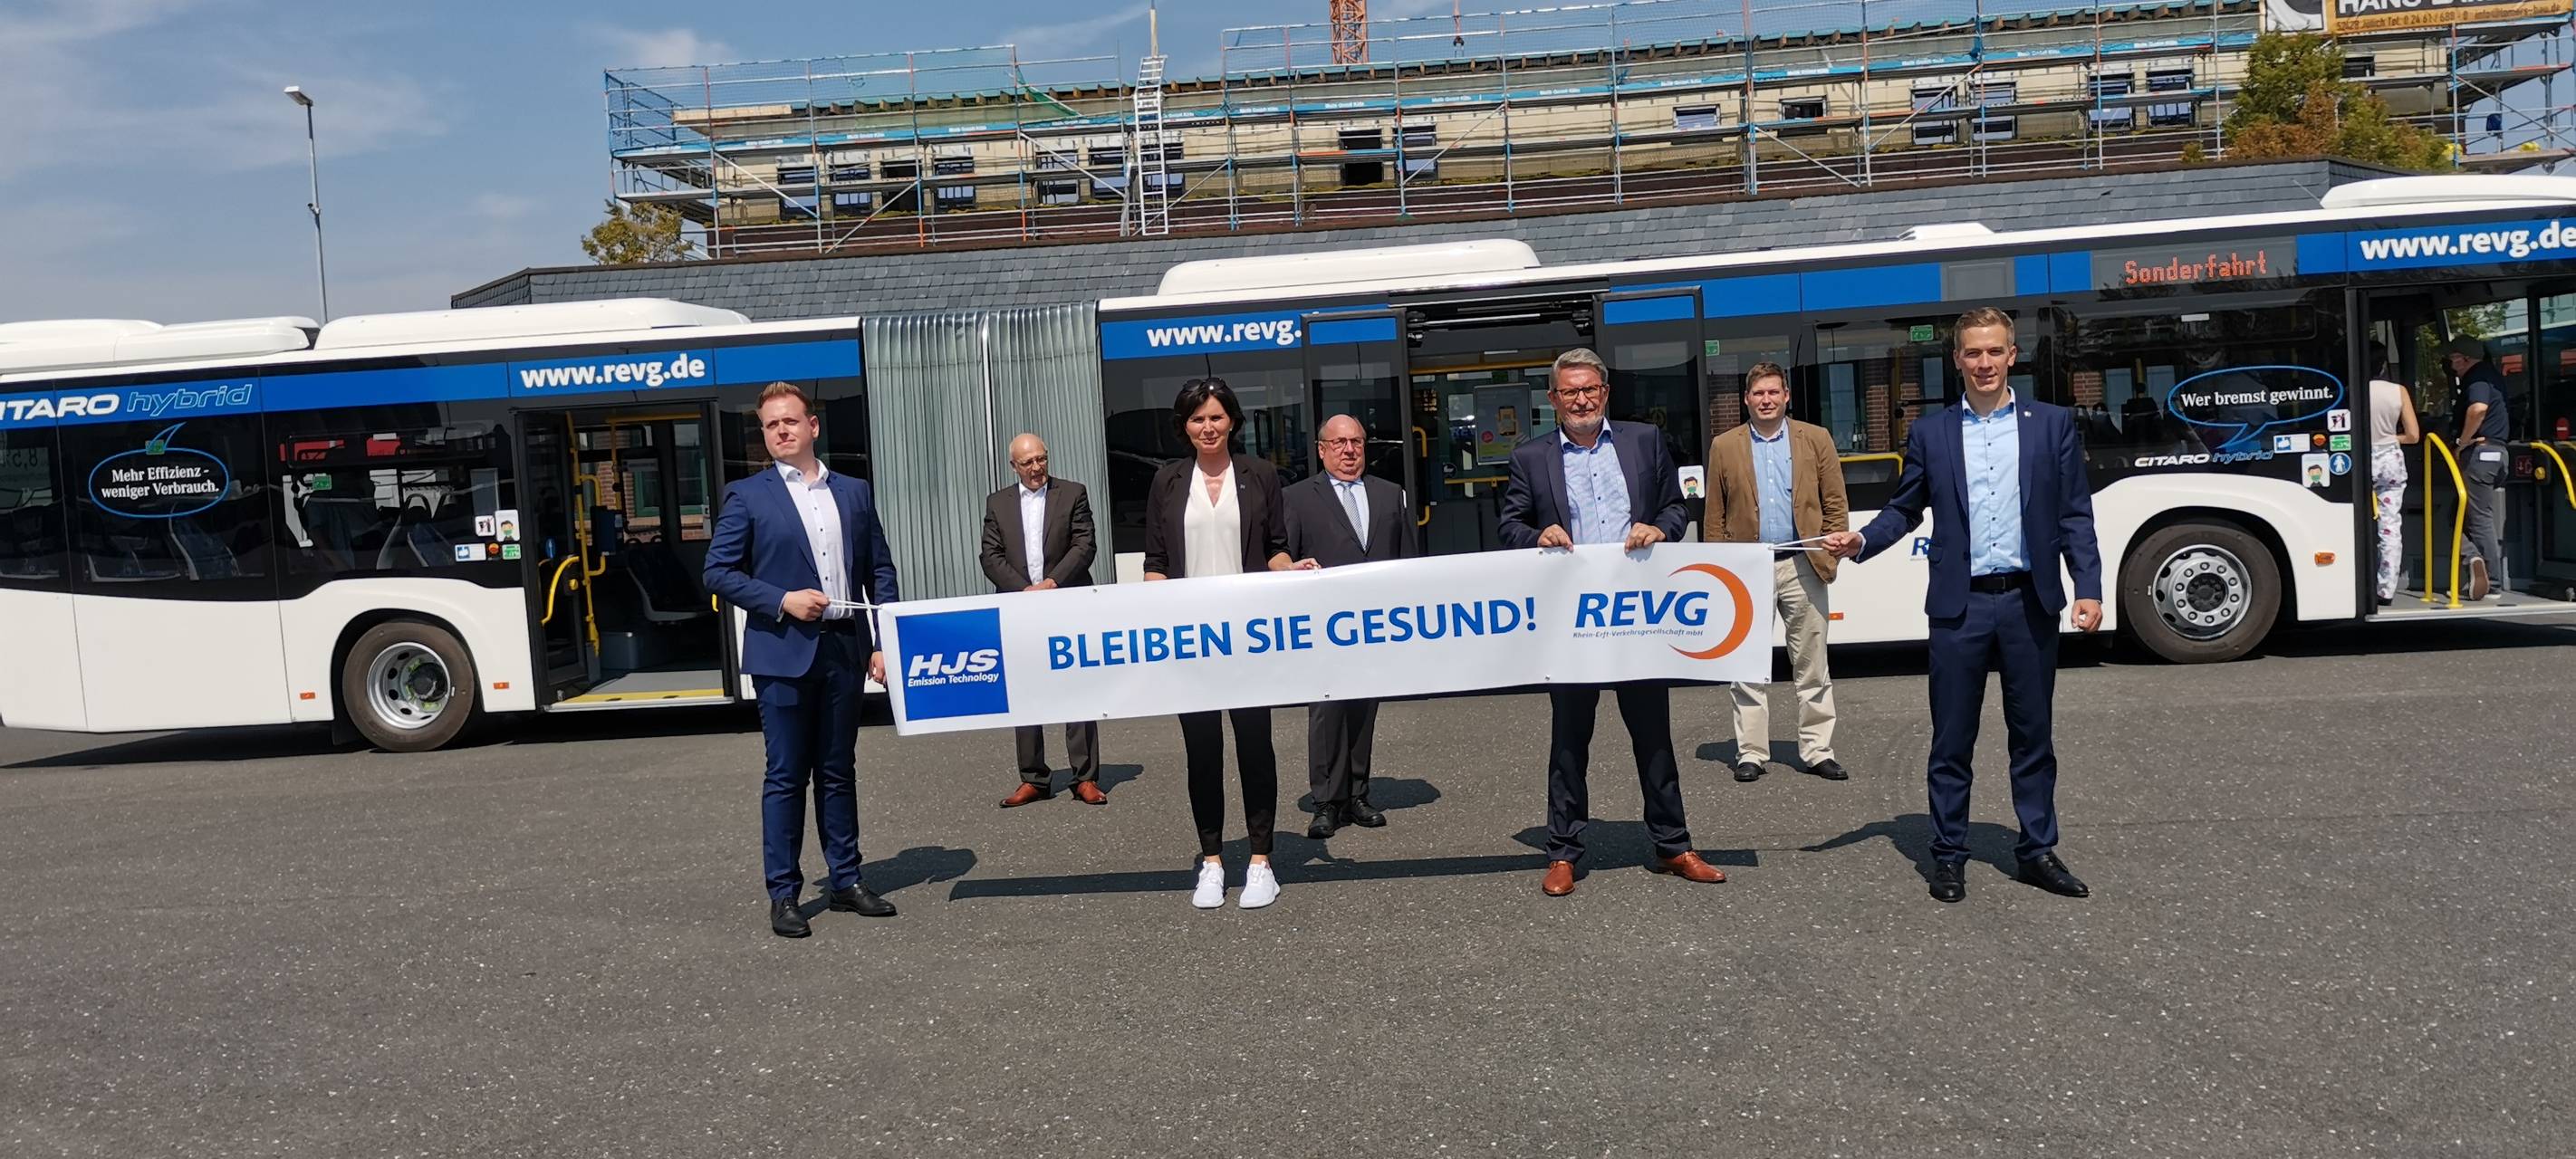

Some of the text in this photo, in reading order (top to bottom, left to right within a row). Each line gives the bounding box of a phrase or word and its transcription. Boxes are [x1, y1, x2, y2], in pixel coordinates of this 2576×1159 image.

[2339, 0, 2422, 14] HA
[2360, 219, 2576, 260] www.revg.de
[2124, 249, 2267, 284] Sonderfahrt
[520, 353, 706, 388] www.revg.de
[126, 383, 253, 417] hybrid
[2180, 386, 2334, 407] Wer bremst gewinnt.
[2134, 449, 2275, 467] CITARO hybrid
[111, 468, 145, 483] Mehr
[147, 465, 202, 481] Effizienz
[101, 479, 219, 500] weniger Verbrauch.
[1574, 590, 1710, 628] REVG
[1048, 597, 1537, 670] BLEIBEN SIE GESUND!
[1686, 629, 1704, 637] mbH
[908, 648, 1000, 677] HJS
[908, 671, 1000, 688] Emission Technology
